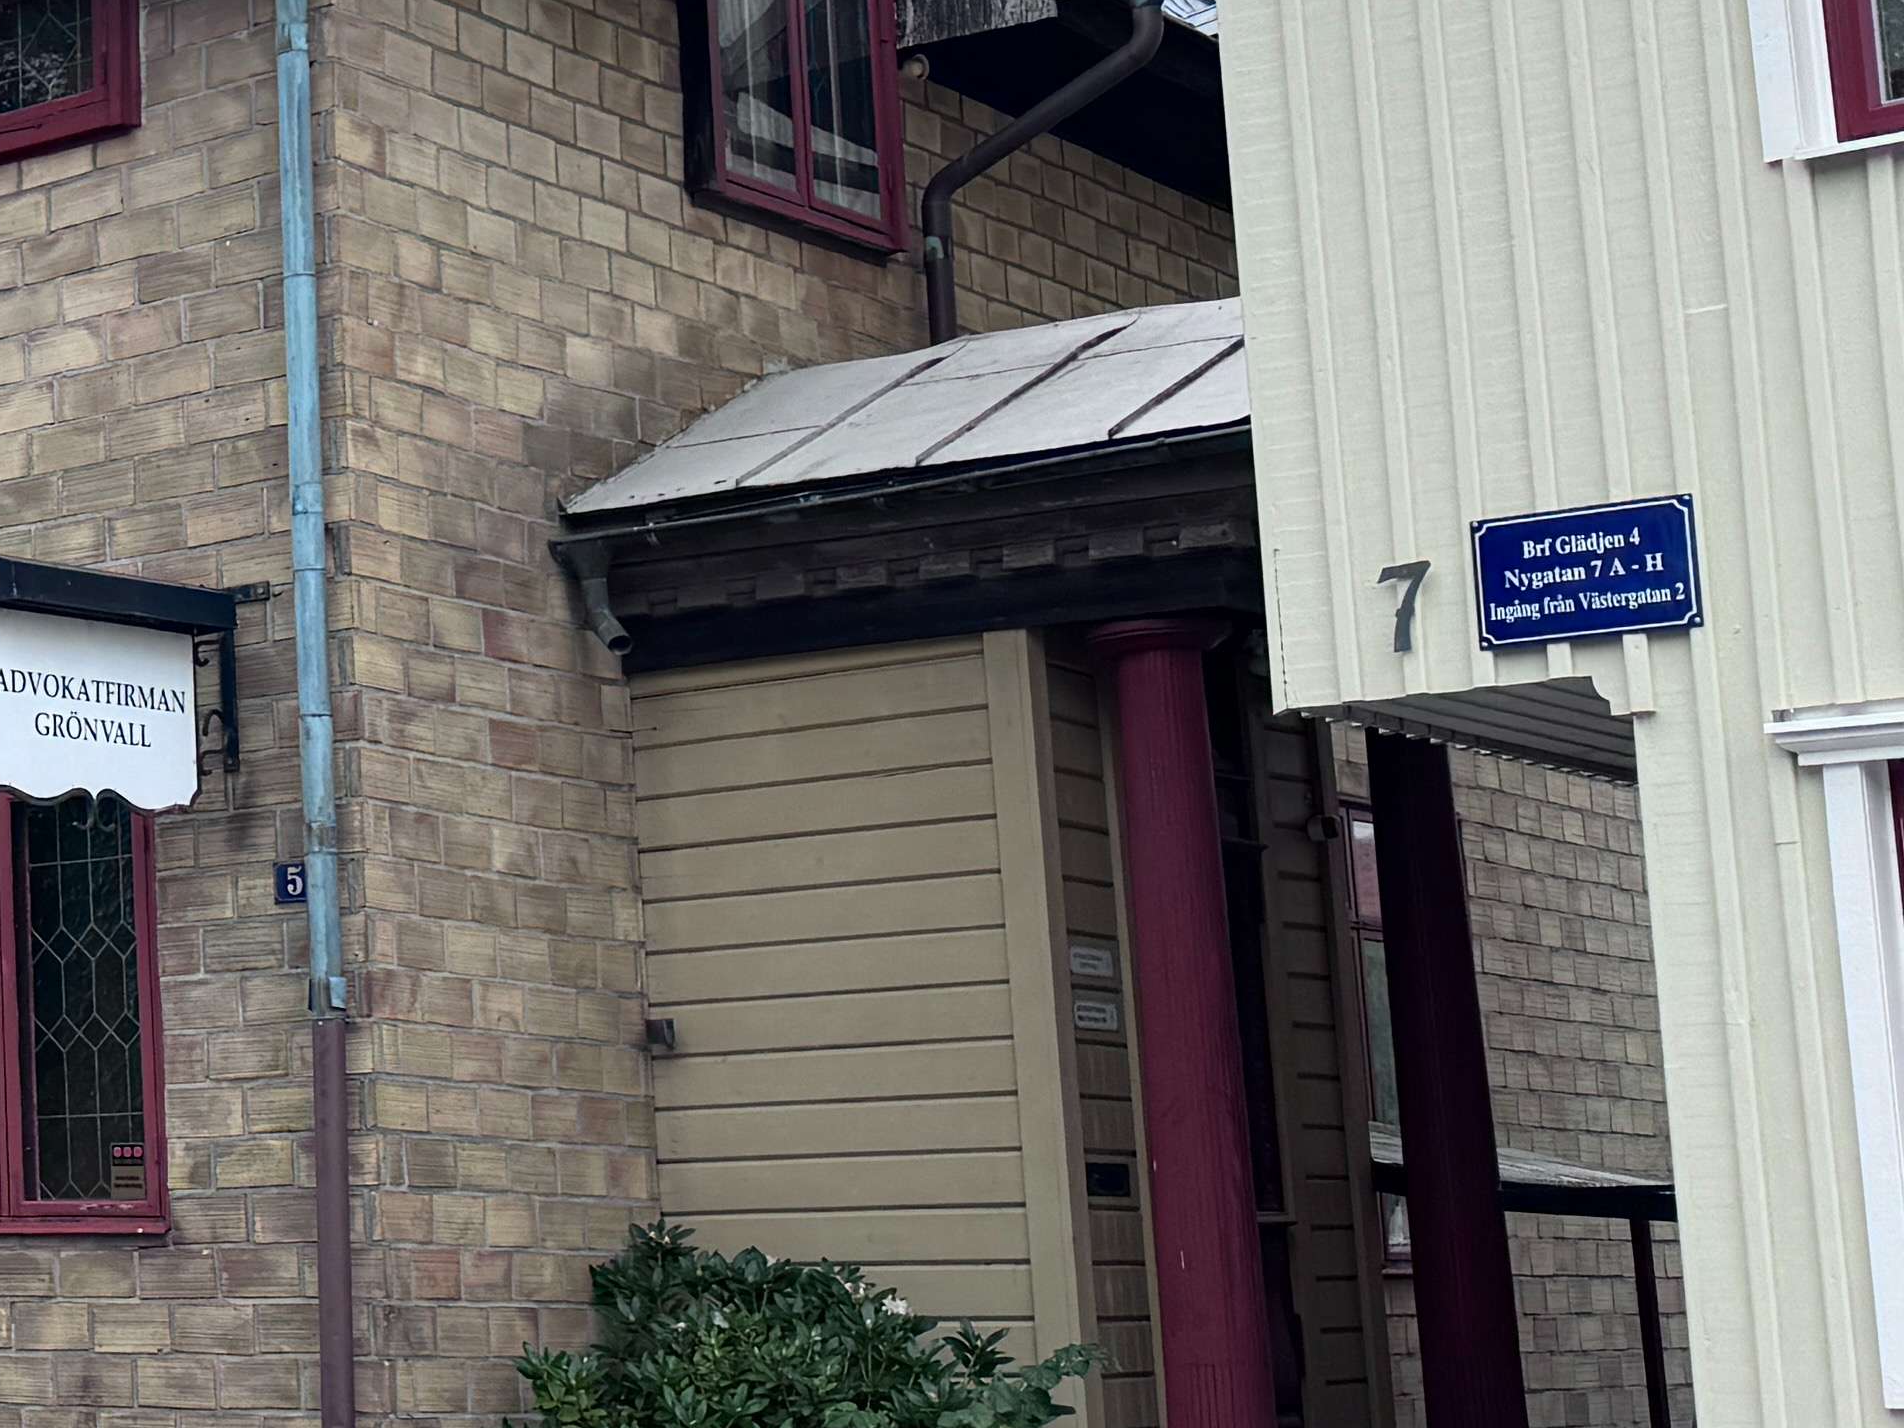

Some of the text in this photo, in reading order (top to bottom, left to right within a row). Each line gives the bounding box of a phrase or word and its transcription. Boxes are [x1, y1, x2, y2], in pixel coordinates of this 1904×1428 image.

[1522, 526, 1640, 559] Brf Glädjen 4
[1504, 565, 1586, 591] Nygatan
[1591, 560, 1603, 578] 7
[1609, 557, 1626, 576] A
[1645, 553, 1664, 572] H
[1377, 560, 1432, 652] 7
[1489, 582, 1686, 623] Ingång från Västergatan 2
[35, 711, 152, 748] GRÖNVALL
[287, 866, 304, 896] 5
